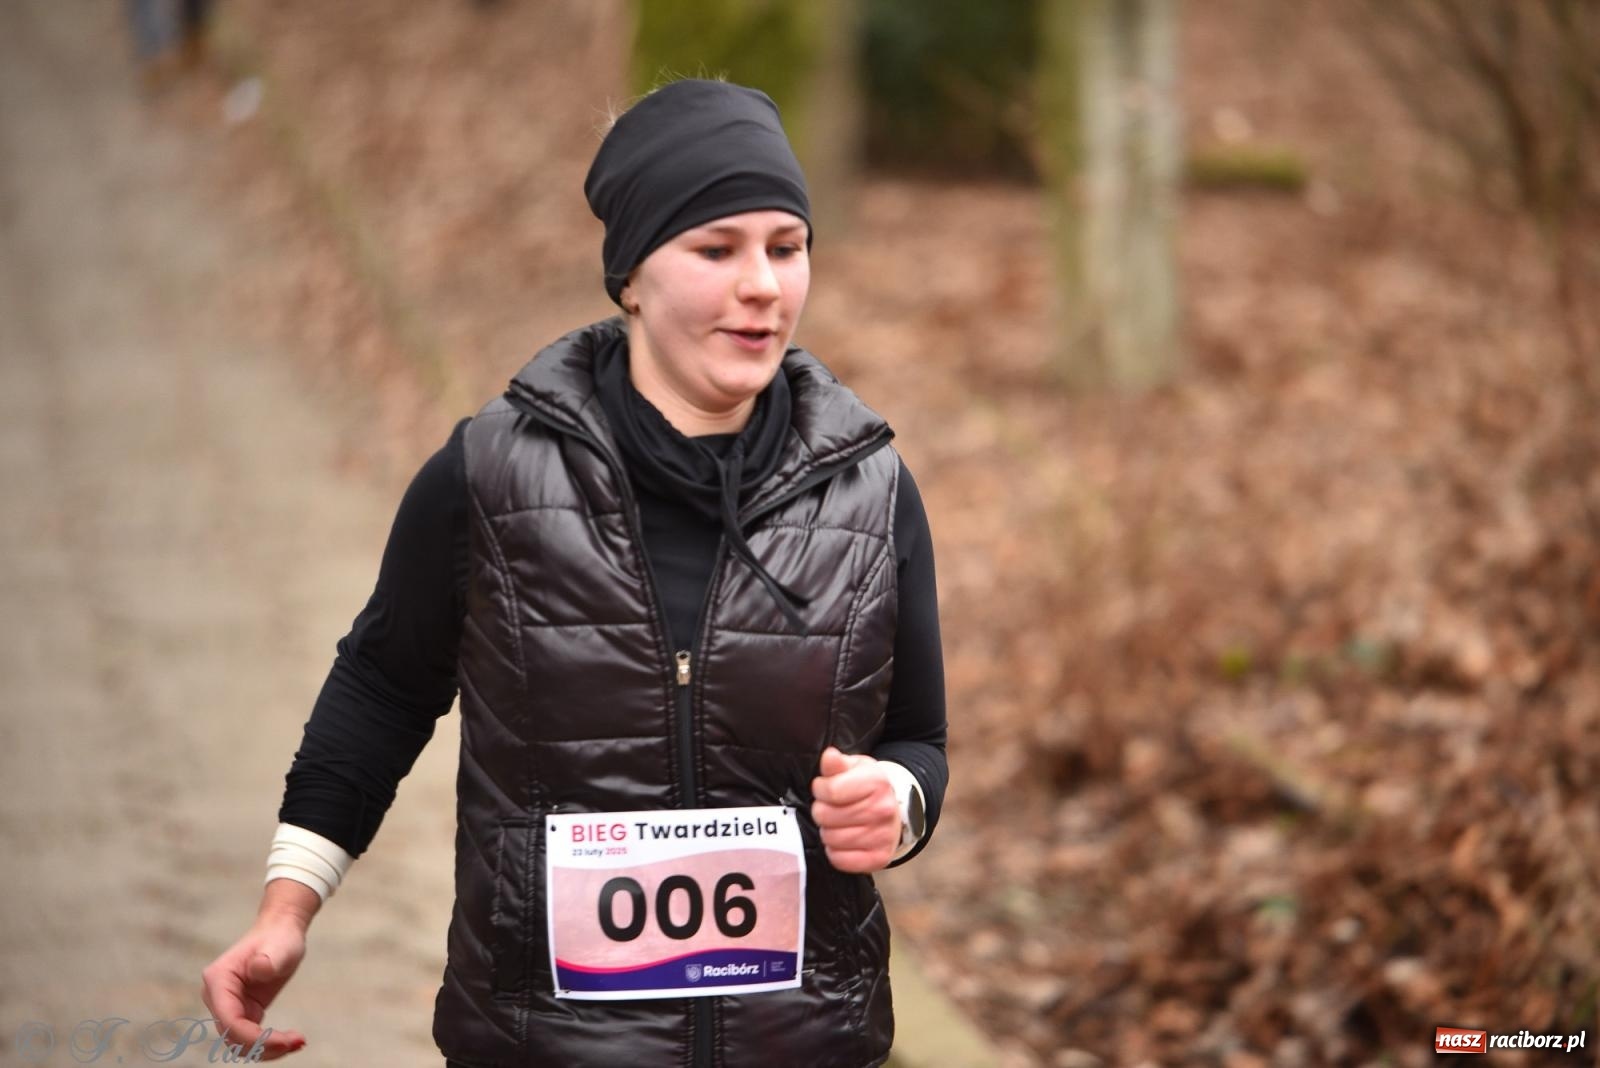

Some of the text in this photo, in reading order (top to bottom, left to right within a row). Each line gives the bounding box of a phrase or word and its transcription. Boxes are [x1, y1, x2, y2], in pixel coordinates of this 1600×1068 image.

[571, 817, 778, 842] BIEG Twardziela
[597, 872, 757, 942] 006
[703, 963, 760, 977] Racibórz
